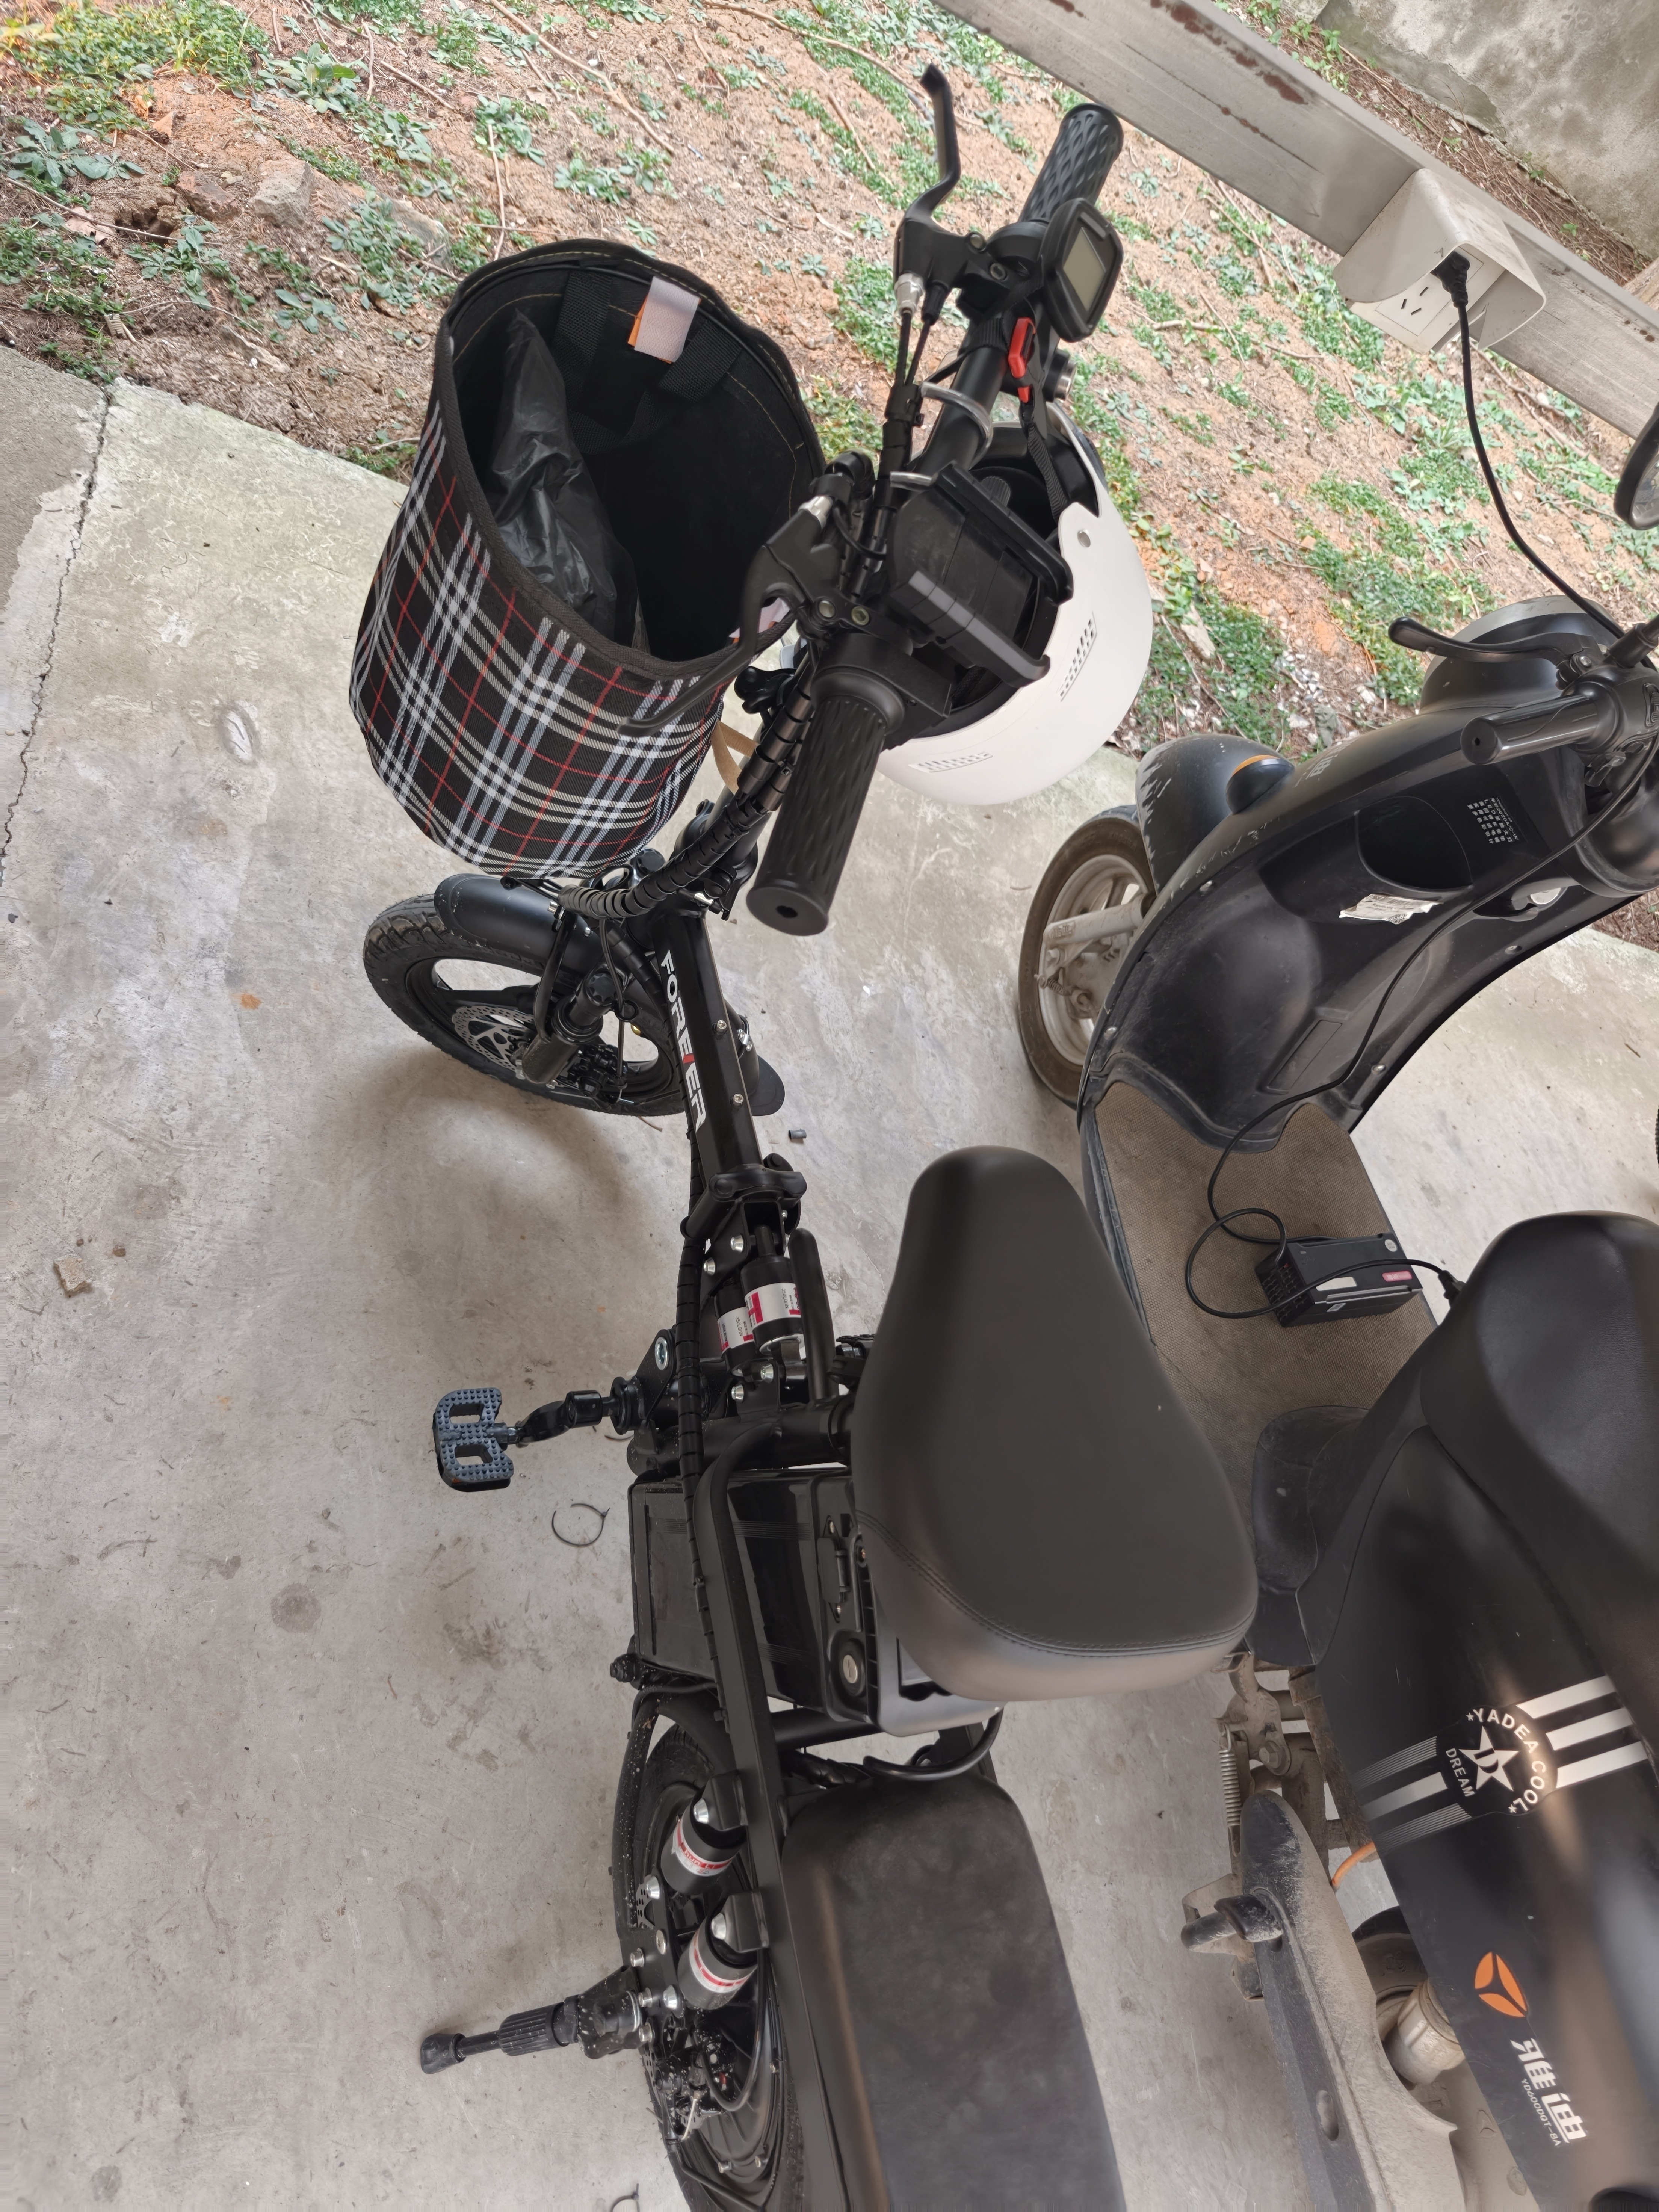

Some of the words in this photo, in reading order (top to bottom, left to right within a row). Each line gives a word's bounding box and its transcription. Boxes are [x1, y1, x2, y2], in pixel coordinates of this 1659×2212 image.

[1446, 1748, 1475, 1797] DREAM
[1472, 1708, 1538, 1754] YADEA
[1512, 1760, 1546, 1811] COOL
[1510, 2038, 1586, 2143] 雅迪
[1521, 2078, 1562, 2146] YD600DQT-8A
